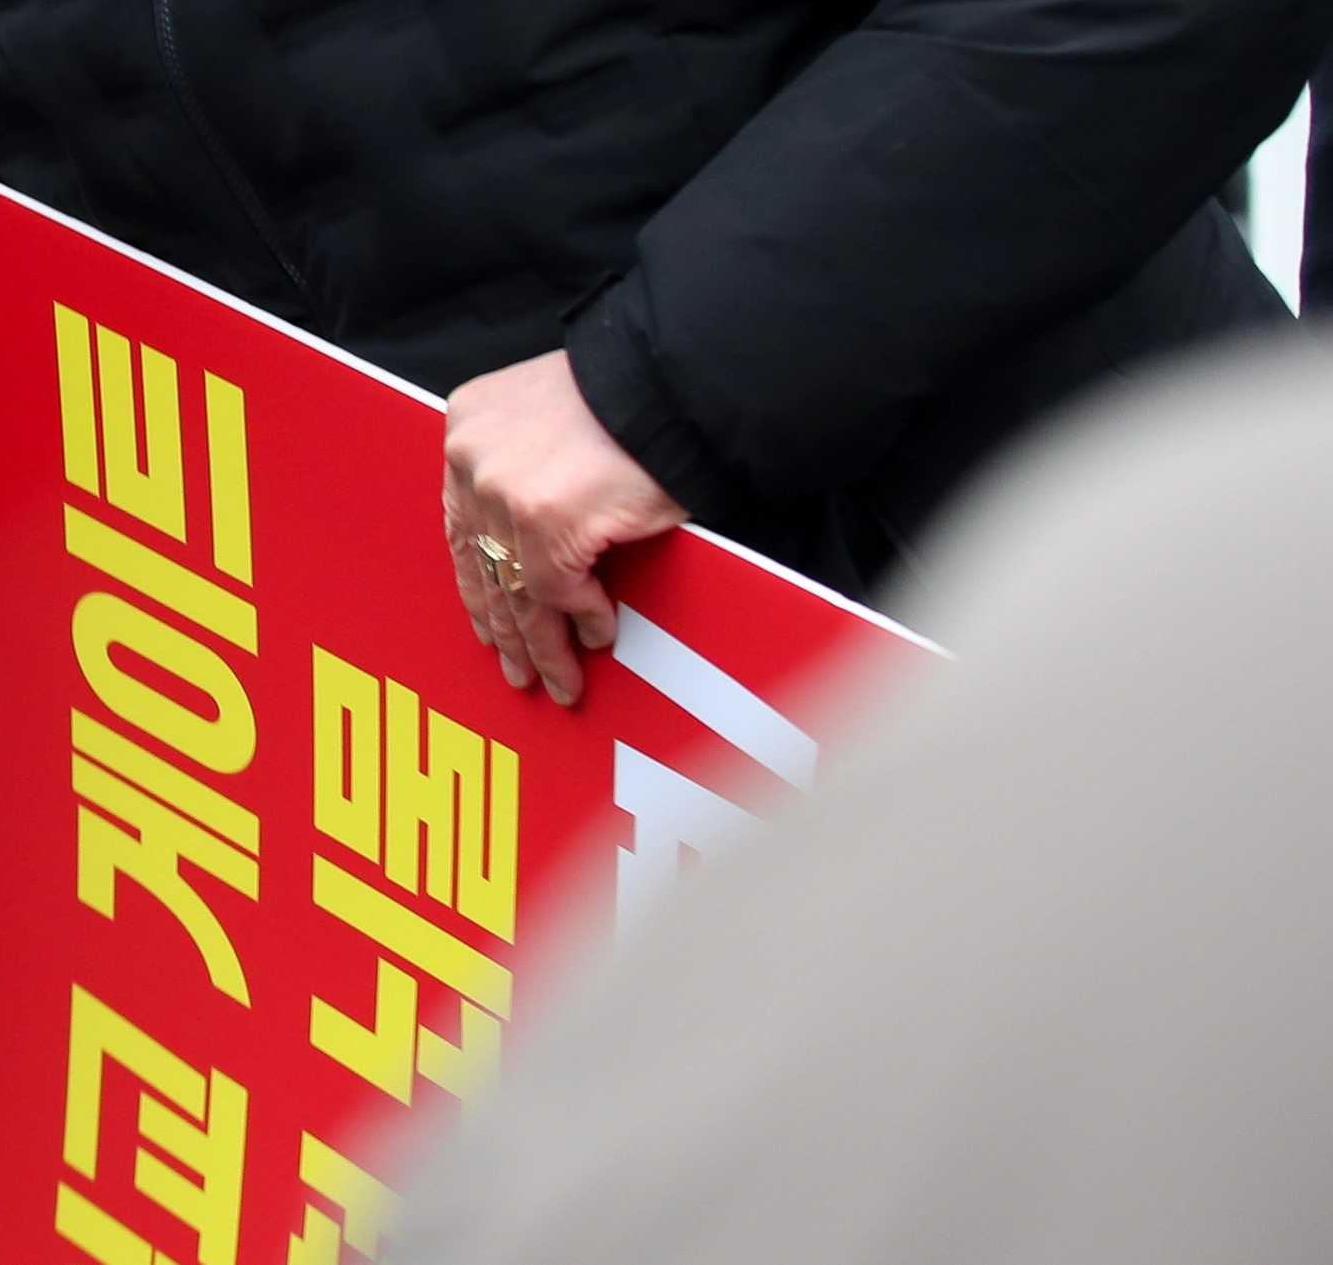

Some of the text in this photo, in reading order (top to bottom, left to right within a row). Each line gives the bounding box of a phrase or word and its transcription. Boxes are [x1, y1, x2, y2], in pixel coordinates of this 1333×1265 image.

[53, 301, 259, 1265] 교 게이트
[310, 644, 520, 1127] 뇌물
